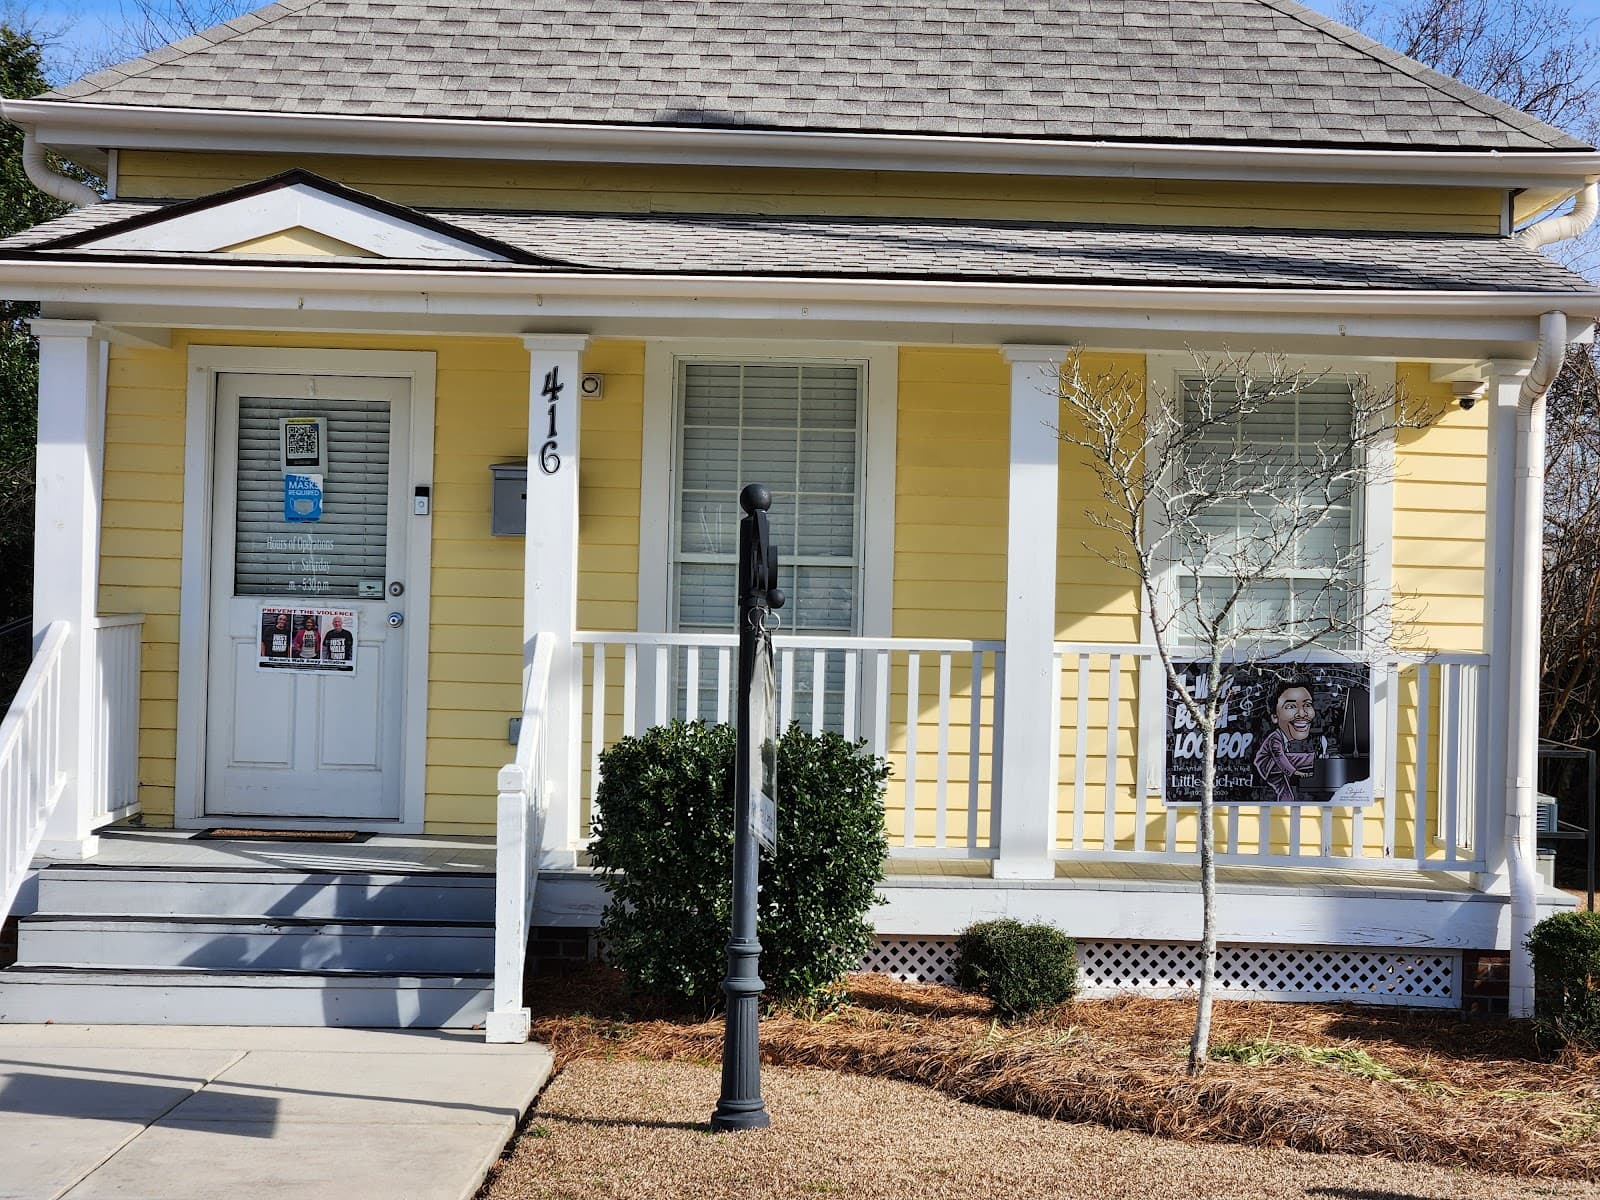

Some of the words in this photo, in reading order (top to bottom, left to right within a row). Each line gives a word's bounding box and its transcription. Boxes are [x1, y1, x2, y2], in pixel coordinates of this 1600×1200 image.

[541, 366, 564, 475] 416
[267, 536, 287, 550] Hours
[289, 536, 297, 550] of
[298, 536, 334, 552] Operations
[301, 558, 329, 573] Saturday
[302, 577, 316, 591] 5:30
[1171, 774, 1201, 788] Little
[1212, 774, 1254, 788] ichard
